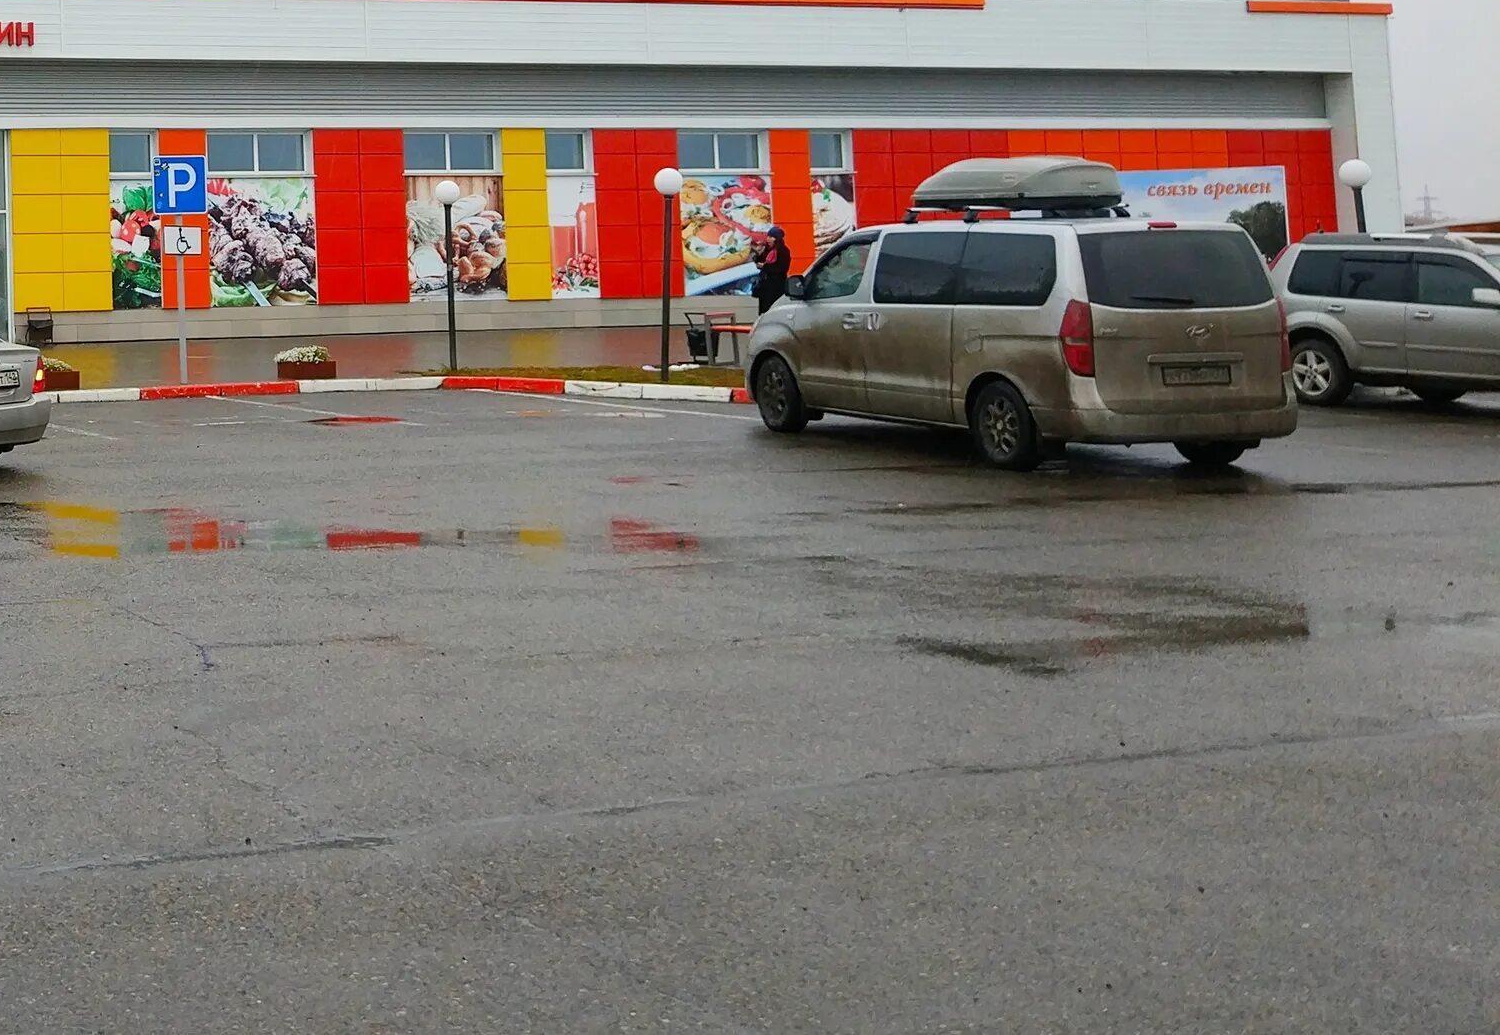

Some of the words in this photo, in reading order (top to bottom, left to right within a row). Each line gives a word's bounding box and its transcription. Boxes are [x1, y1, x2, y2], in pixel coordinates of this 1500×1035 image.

[168, 162, 197, 208] P
[1147, 184, 1198, 196] связь
[1203, 181, 1272, 200] времен
